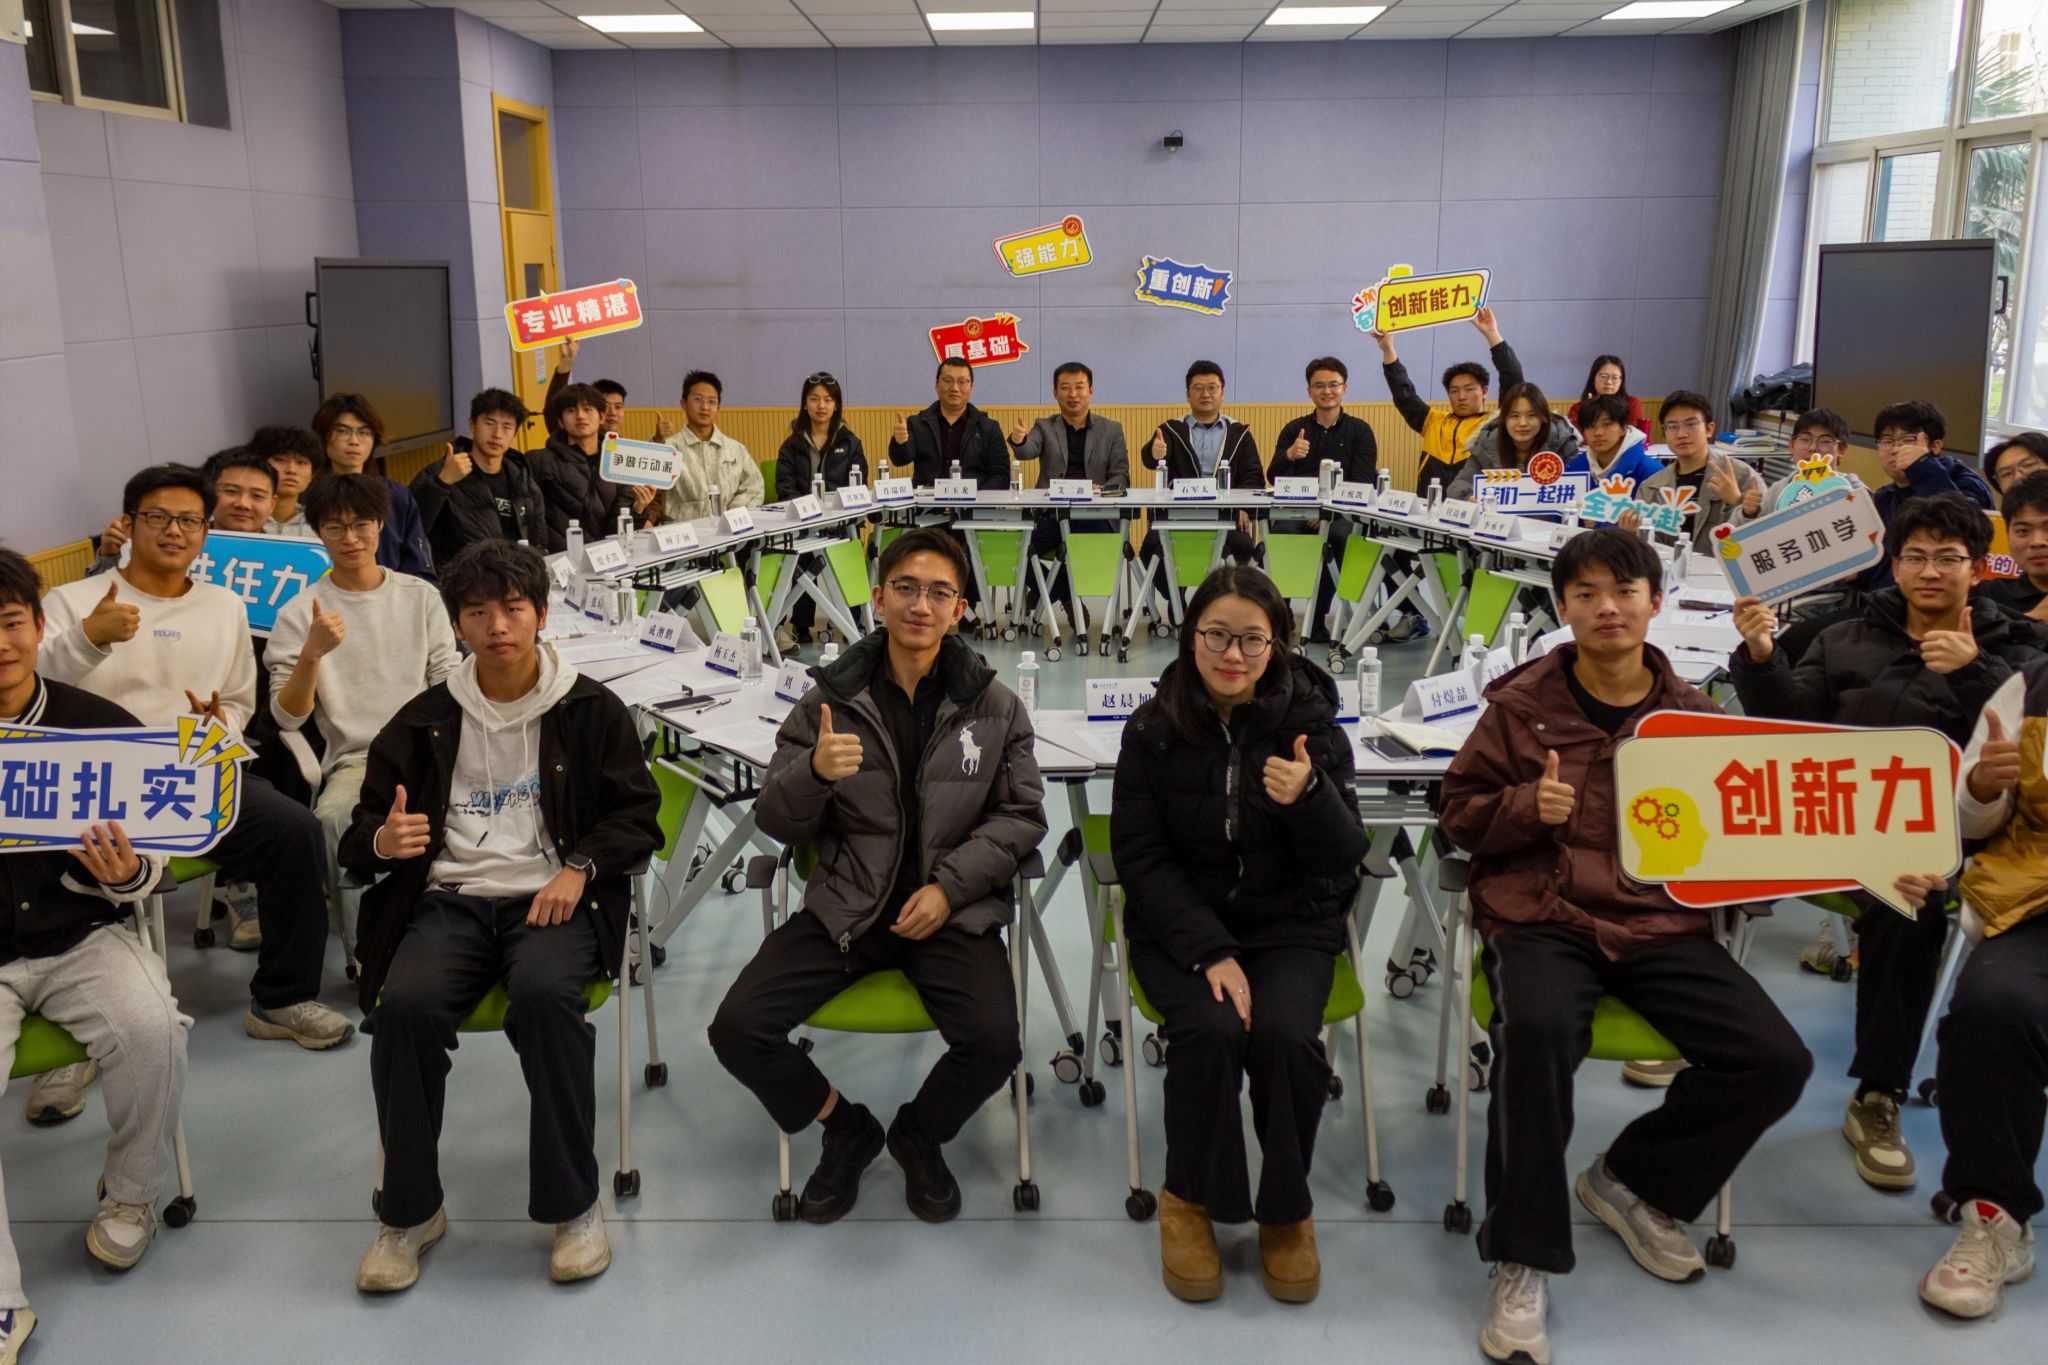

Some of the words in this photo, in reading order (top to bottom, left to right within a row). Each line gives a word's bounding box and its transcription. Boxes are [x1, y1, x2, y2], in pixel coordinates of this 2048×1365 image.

[1014, 238, 1079, 269] 强能力
[1148, 268, 1213, 300] 重创新
[1387, 283, 1470, 318] 创新能力
[522, 292, 629, 334] 专业精湛
[944, 335, 1011, 360] 厚基础
[613, 453, 673, 474] 争做行动派
[1750, 516, 1858, 576] 服务办学
[0, 760, 197, 822] 础扎实
[1714, 755, 1938, 838] 创新力
